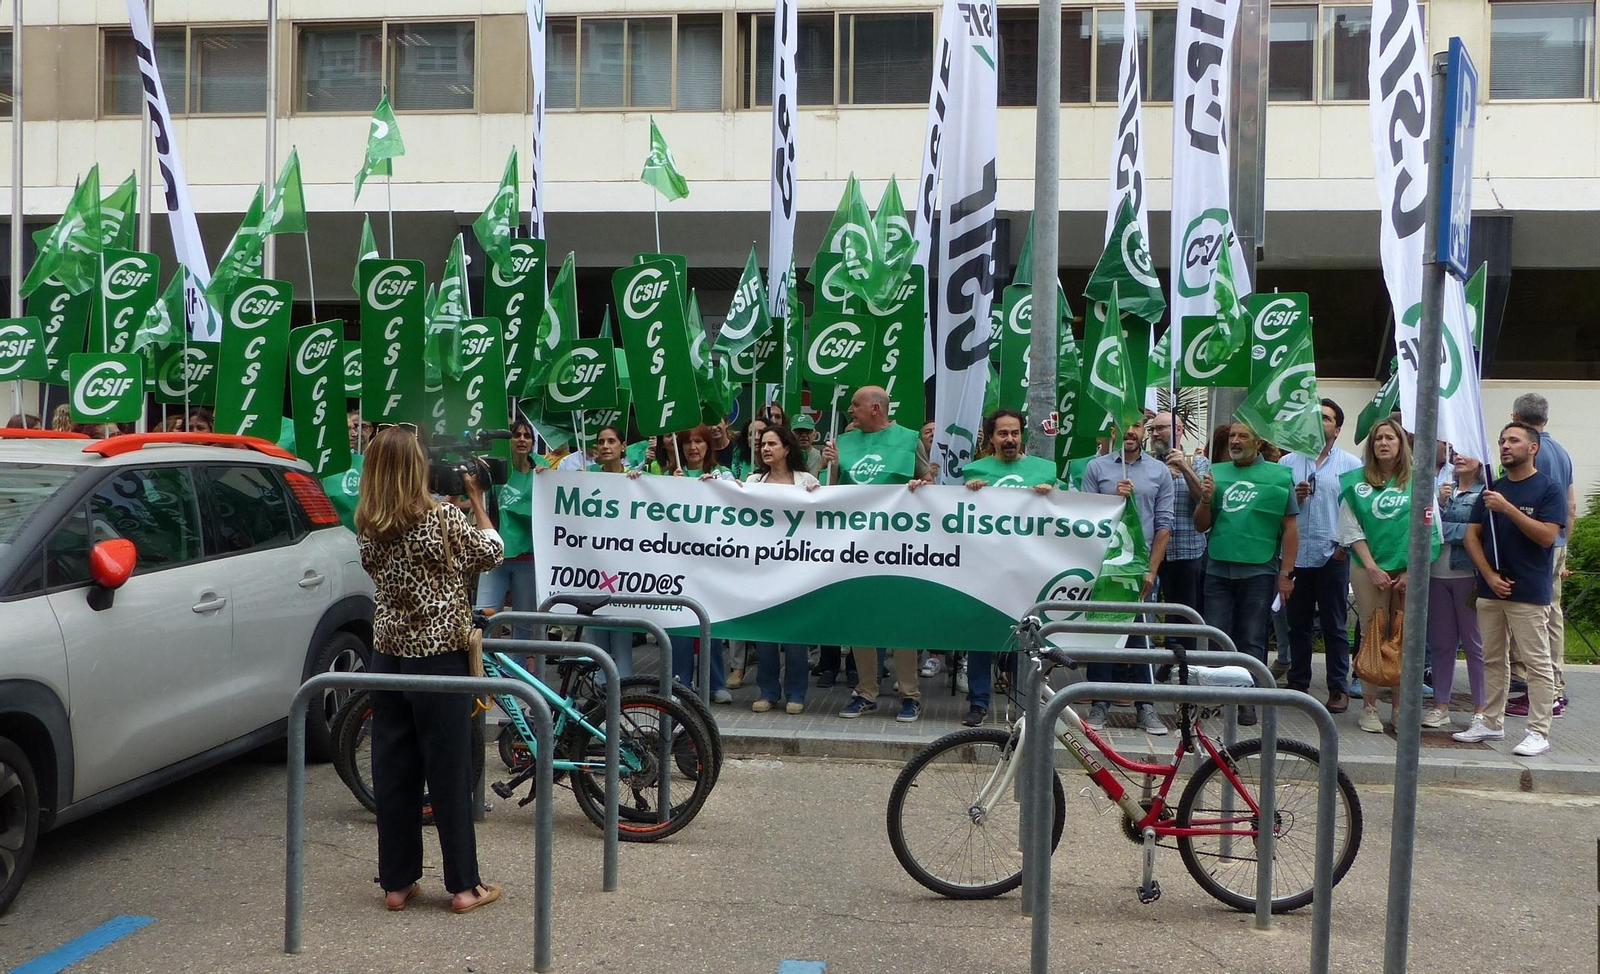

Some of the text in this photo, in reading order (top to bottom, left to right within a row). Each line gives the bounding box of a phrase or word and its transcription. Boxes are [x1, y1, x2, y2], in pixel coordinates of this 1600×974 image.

[1459, 71, 1472, 149] P
[111, 269, 152, 288] CSIF
[377, 279, 417, 296] CSIF
[632, 280, 669, 304] CSIF
[241, 297, 285, 316] CSIF
[1263, 310, 1302, 327] CSIF
[304, 339, 338, 361] CSIF
[505, 292, 525, 390] CSIF
[820, 337, 866, 359] CSIF
[382, 316, 404, 416] CSIF
[560, 363, 606, 385] CSIF
[646, 321, 676, 428] CSIF
[86, 378, 134, 397] CSIF
[236, 336, 266, 436] CSIF
[312, 376, 332, 473] CSIF
[857, 462, 885, 476] CSIF
[1228, 490, 1258, 502] CSIF
[1379, 495, 1409, 508] CSIF
[554, 486, 1112, 539] Más recursos y menos discursos
[554, 526, 960, 567] Por una educación pública de calidad
